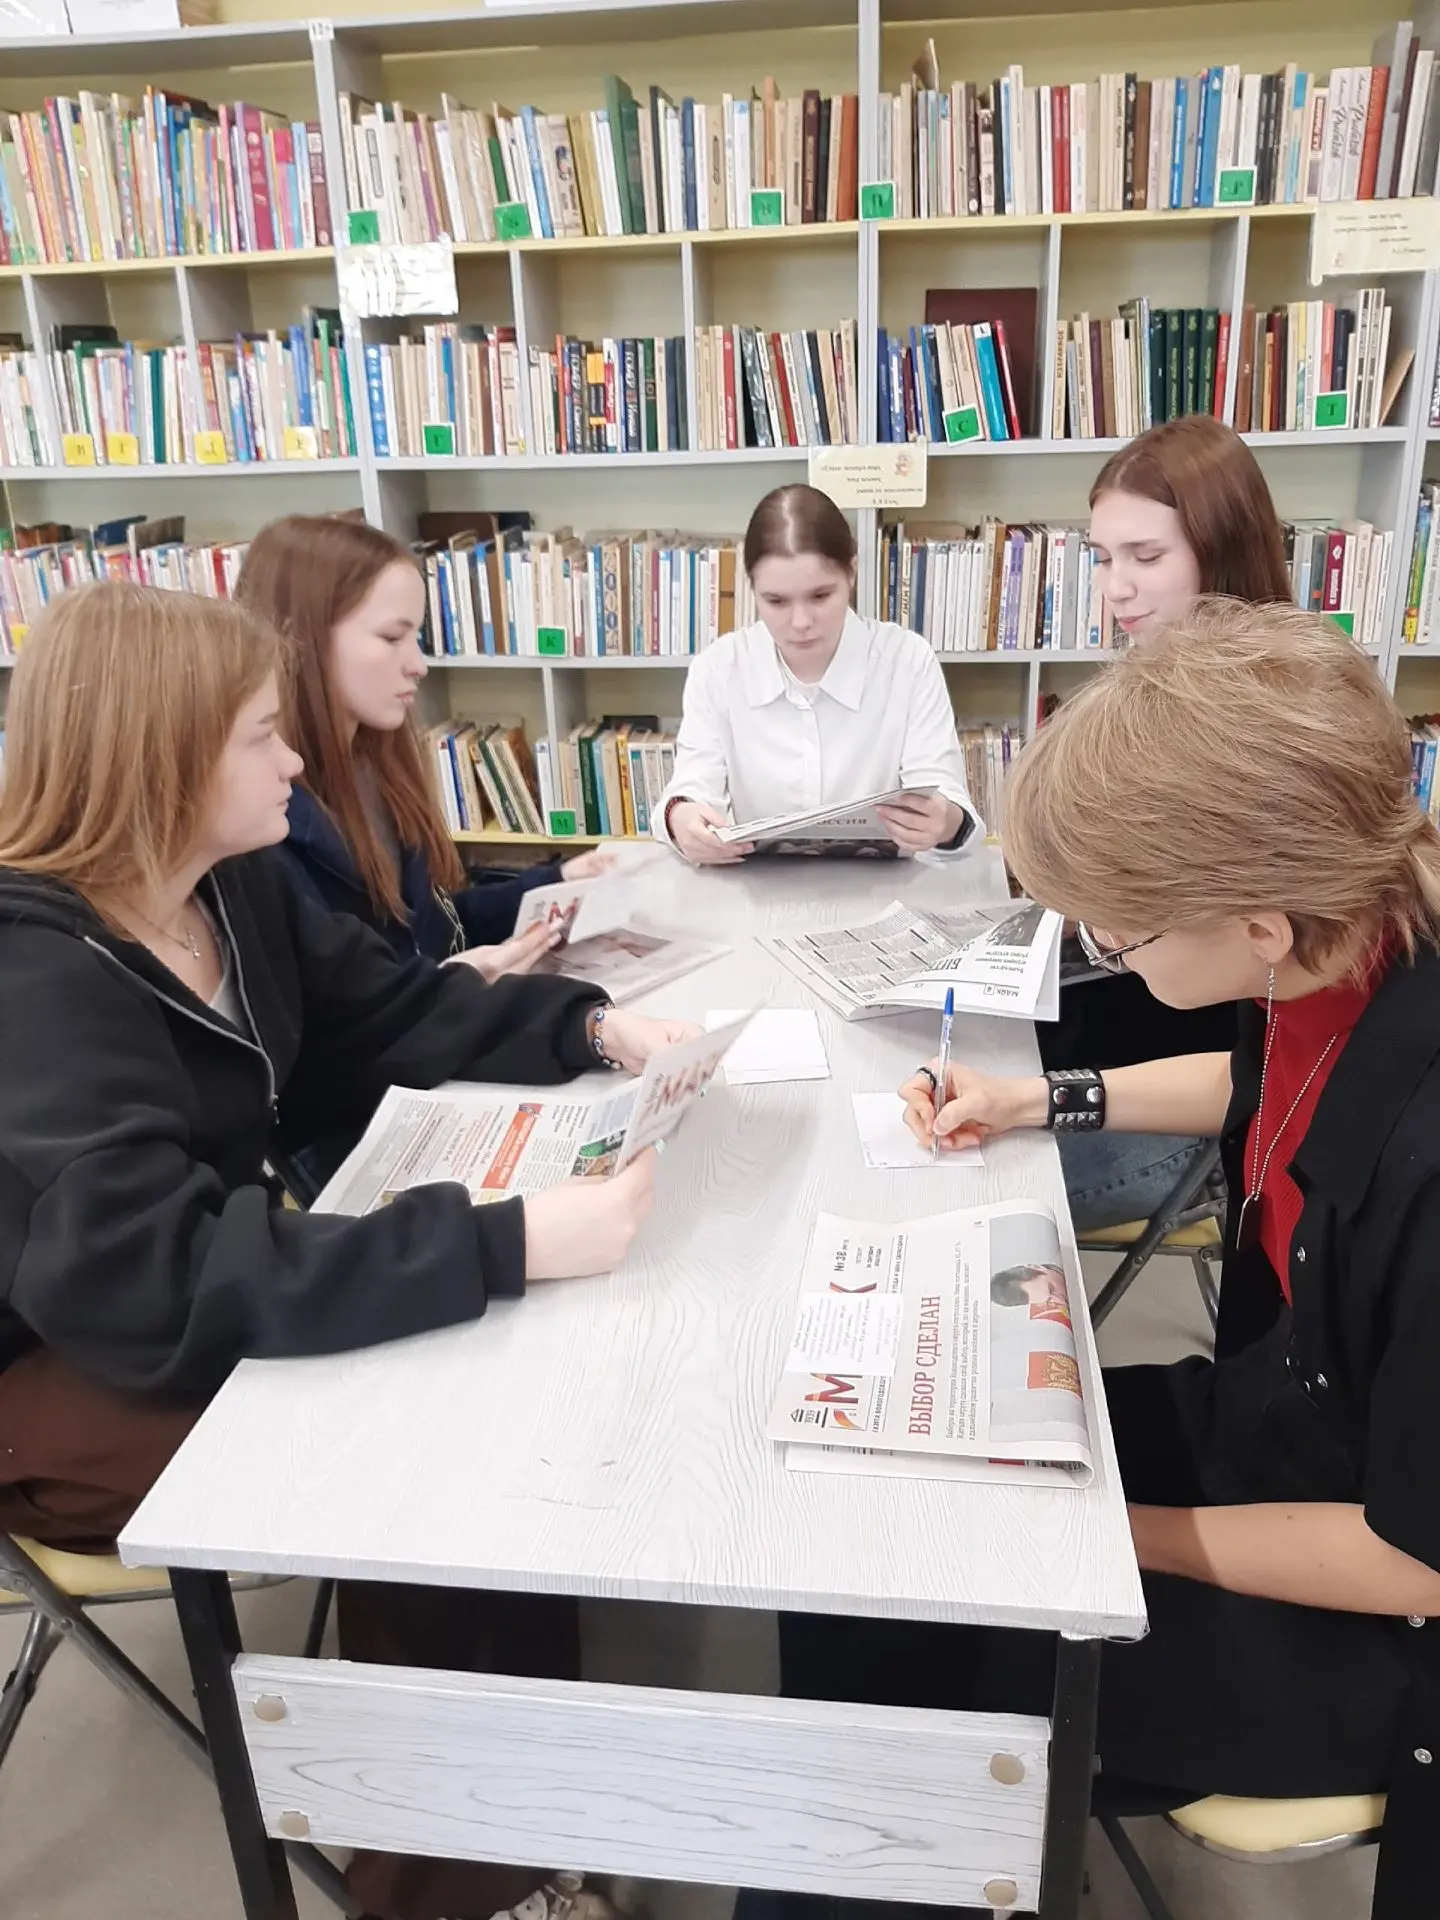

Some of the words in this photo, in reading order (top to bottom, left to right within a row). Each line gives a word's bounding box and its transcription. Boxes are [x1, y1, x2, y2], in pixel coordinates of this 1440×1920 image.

[872, 194, 883, 207] П
[1326, 403, 1339, 416] Т
[957, 418, 968, 434] С
[546, 635, 557, 648] К
[556, 817, 569, 830] М
[996, 987, 1019, 997] МАЯК
[836, 1250, 847, 1262] 38
[916, 1295, 941, 1365] СДЕЛАН
[908, 1371, 936, 1436] ВЫБОР
